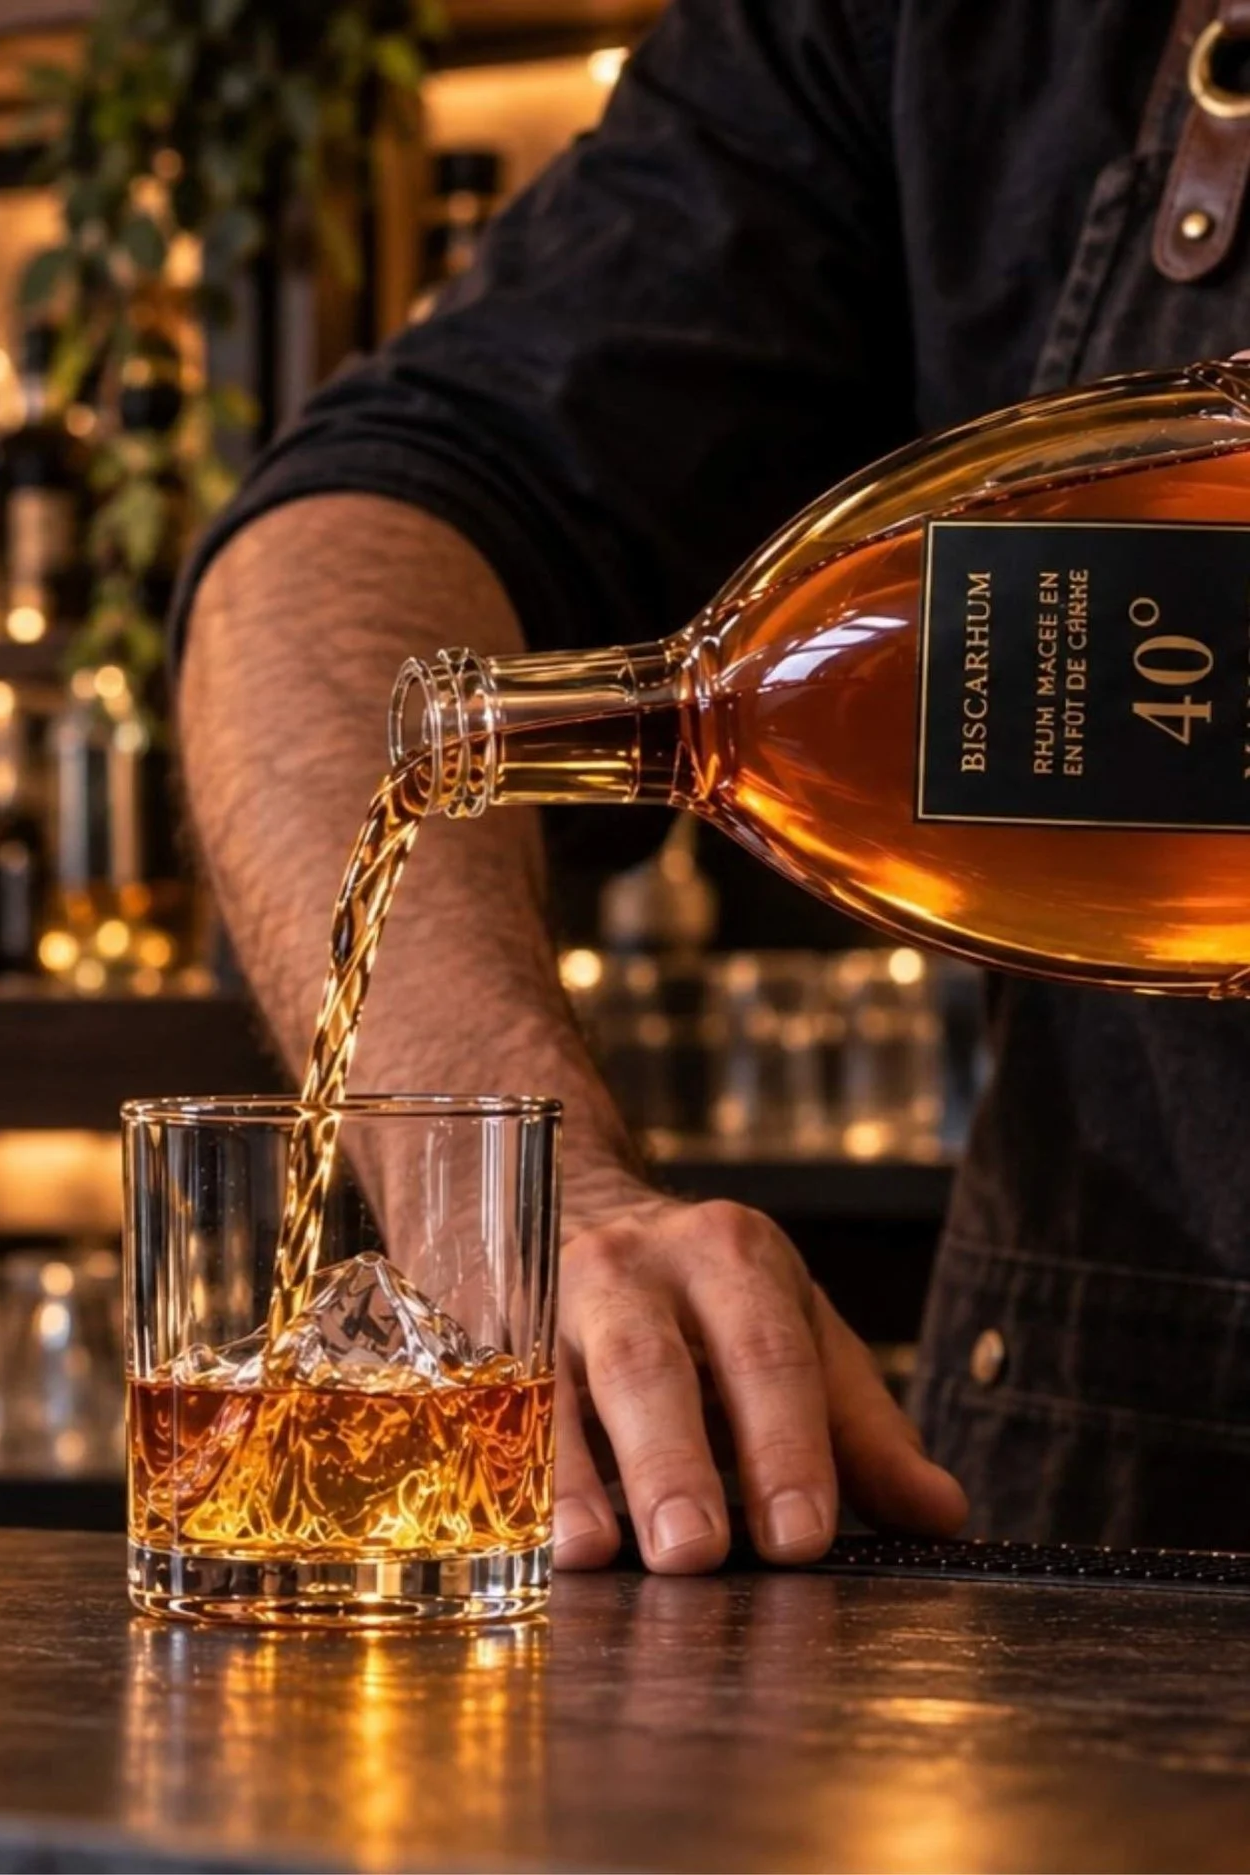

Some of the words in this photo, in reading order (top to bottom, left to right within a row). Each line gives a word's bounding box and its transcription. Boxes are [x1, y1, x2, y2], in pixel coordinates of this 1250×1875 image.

[1039, 572, 1059, 604] EN
[961, 571, 991, 773] BISCARHUM
[1066, 658, 1087, 690] DE
[1033, 706, 1055, 774] RHUM
[1063, 746, 1083, 776] EN
